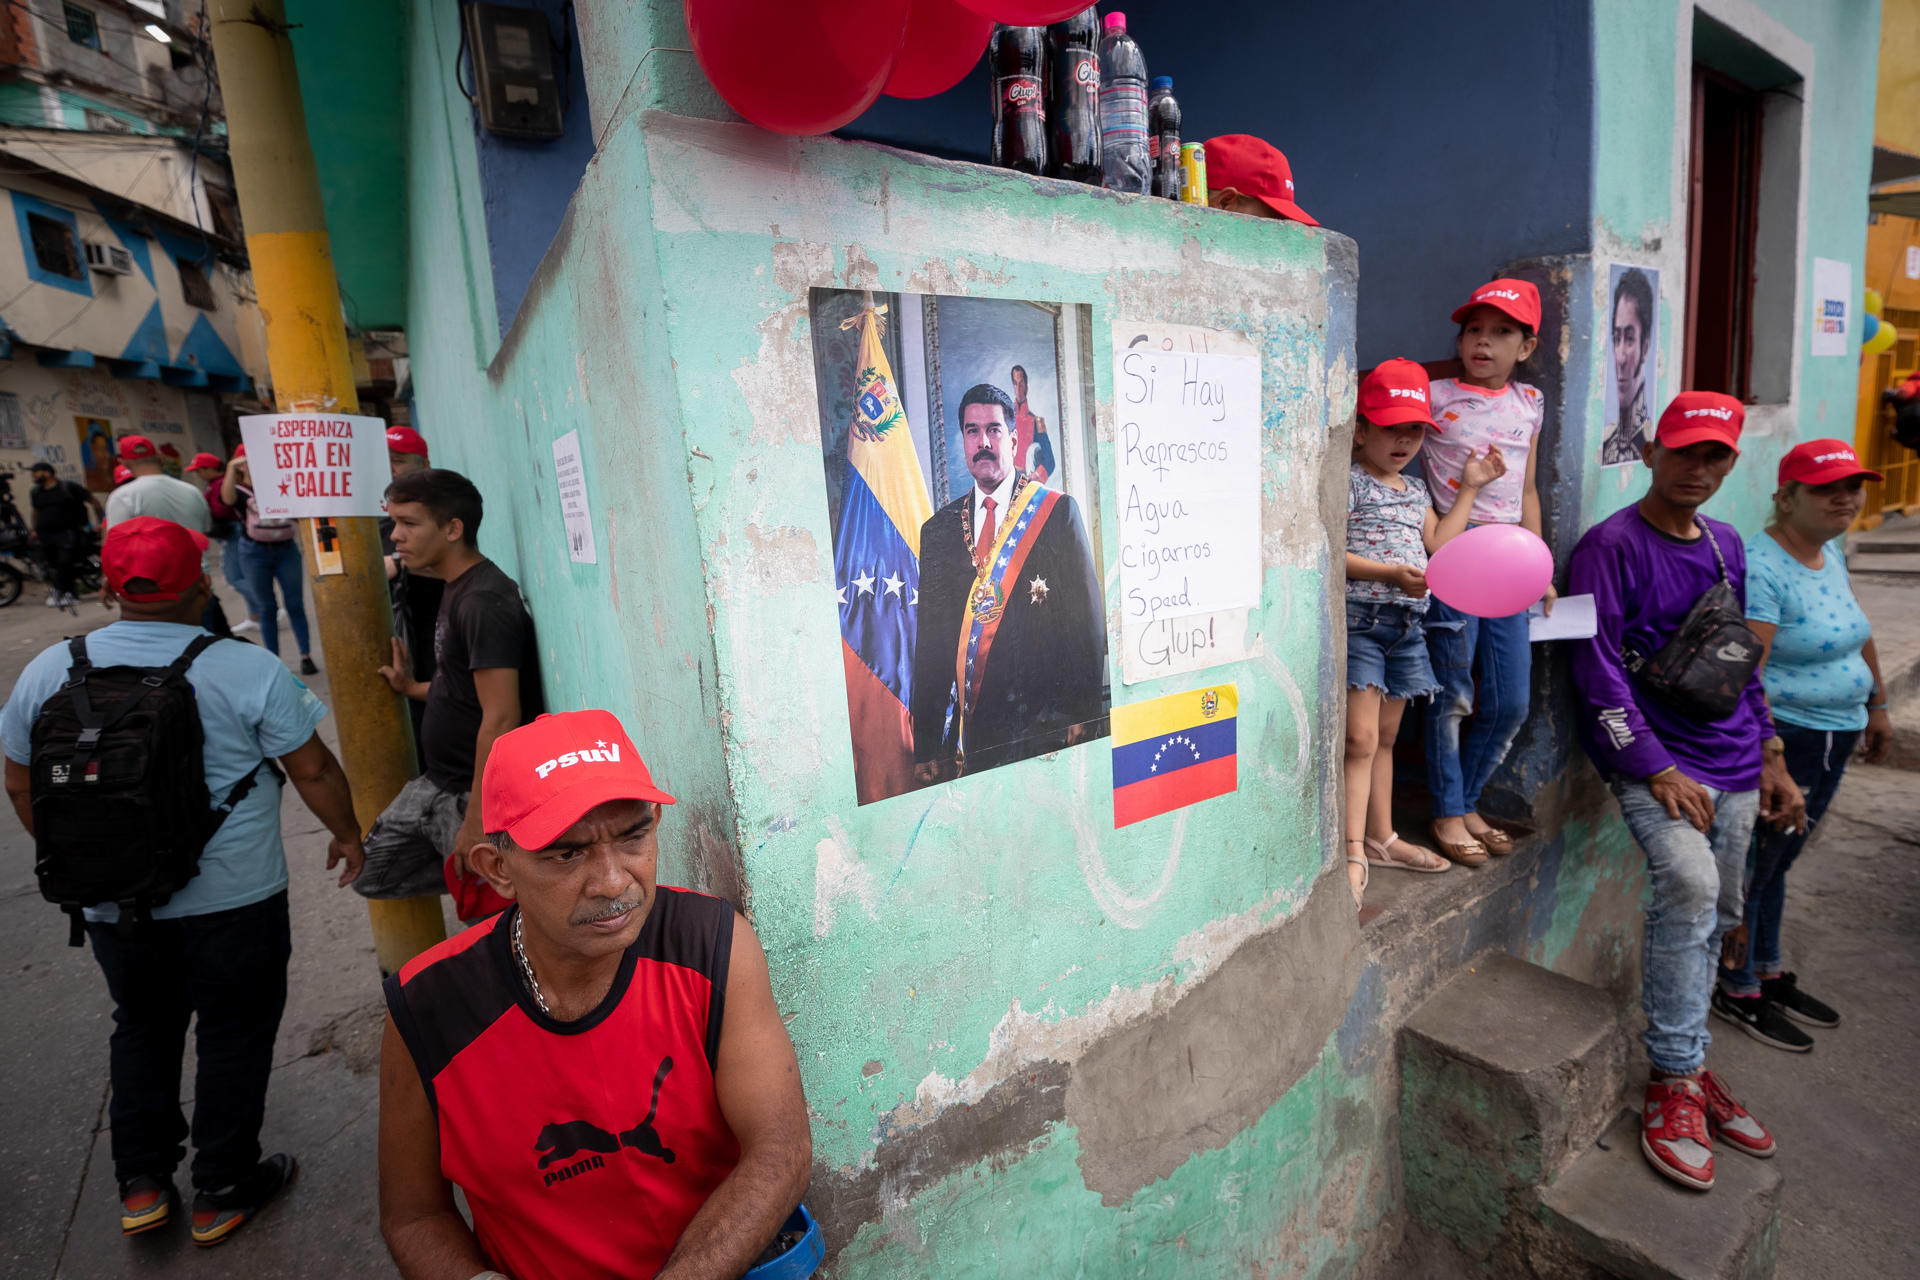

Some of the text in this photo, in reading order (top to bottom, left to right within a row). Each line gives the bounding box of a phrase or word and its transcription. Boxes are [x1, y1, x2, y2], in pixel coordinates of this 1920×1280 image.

[1010, 84, 1036, 99] Glup!
[1123, 353, 1226, 422] Si Hay
[277, 420, 354, 439] ESPERANZA
[273, 437, 351, 469] ESTÁ EN
[294, 471, 353, 498] CALLE
[1125, 484, 1189, 535] Agua
[1121, 542, 1212, 581] Cigarros
[1138, 616, 1215, 667] Glup!
